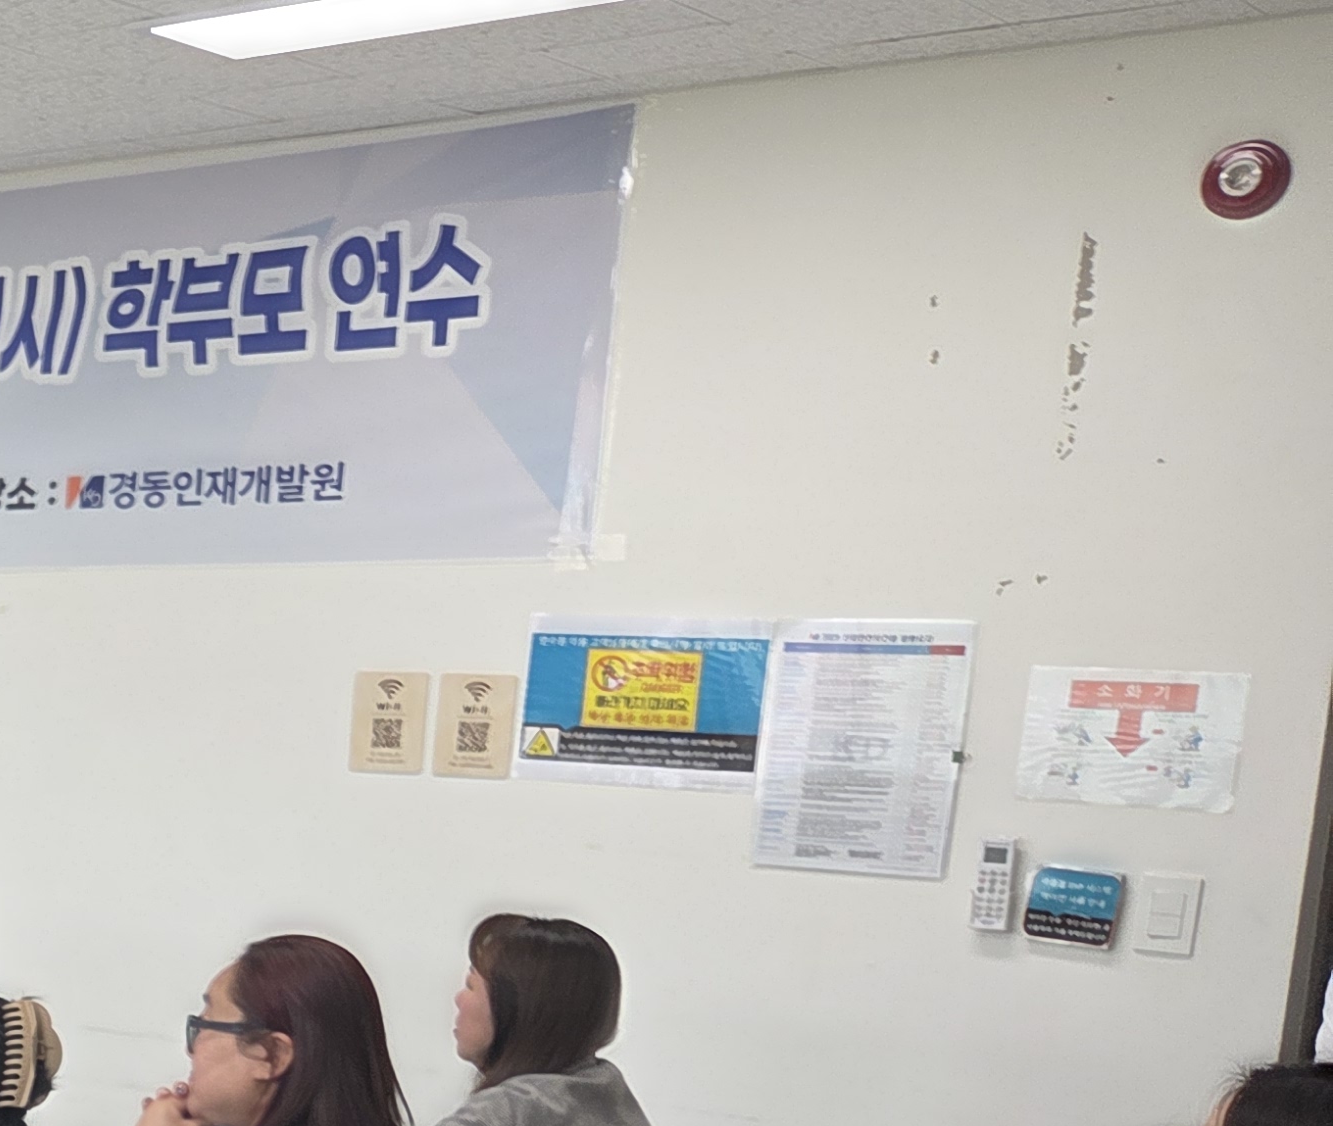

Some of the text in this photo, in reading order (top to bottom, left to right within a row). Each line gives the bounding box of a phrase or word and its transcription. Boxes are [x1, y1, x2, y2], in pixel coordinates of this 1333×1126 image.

[104, 245, 309, 368] 학부모
[329, 224, 481, 352] 연수
[109, 461, 345, 510] 경동인재개발원
